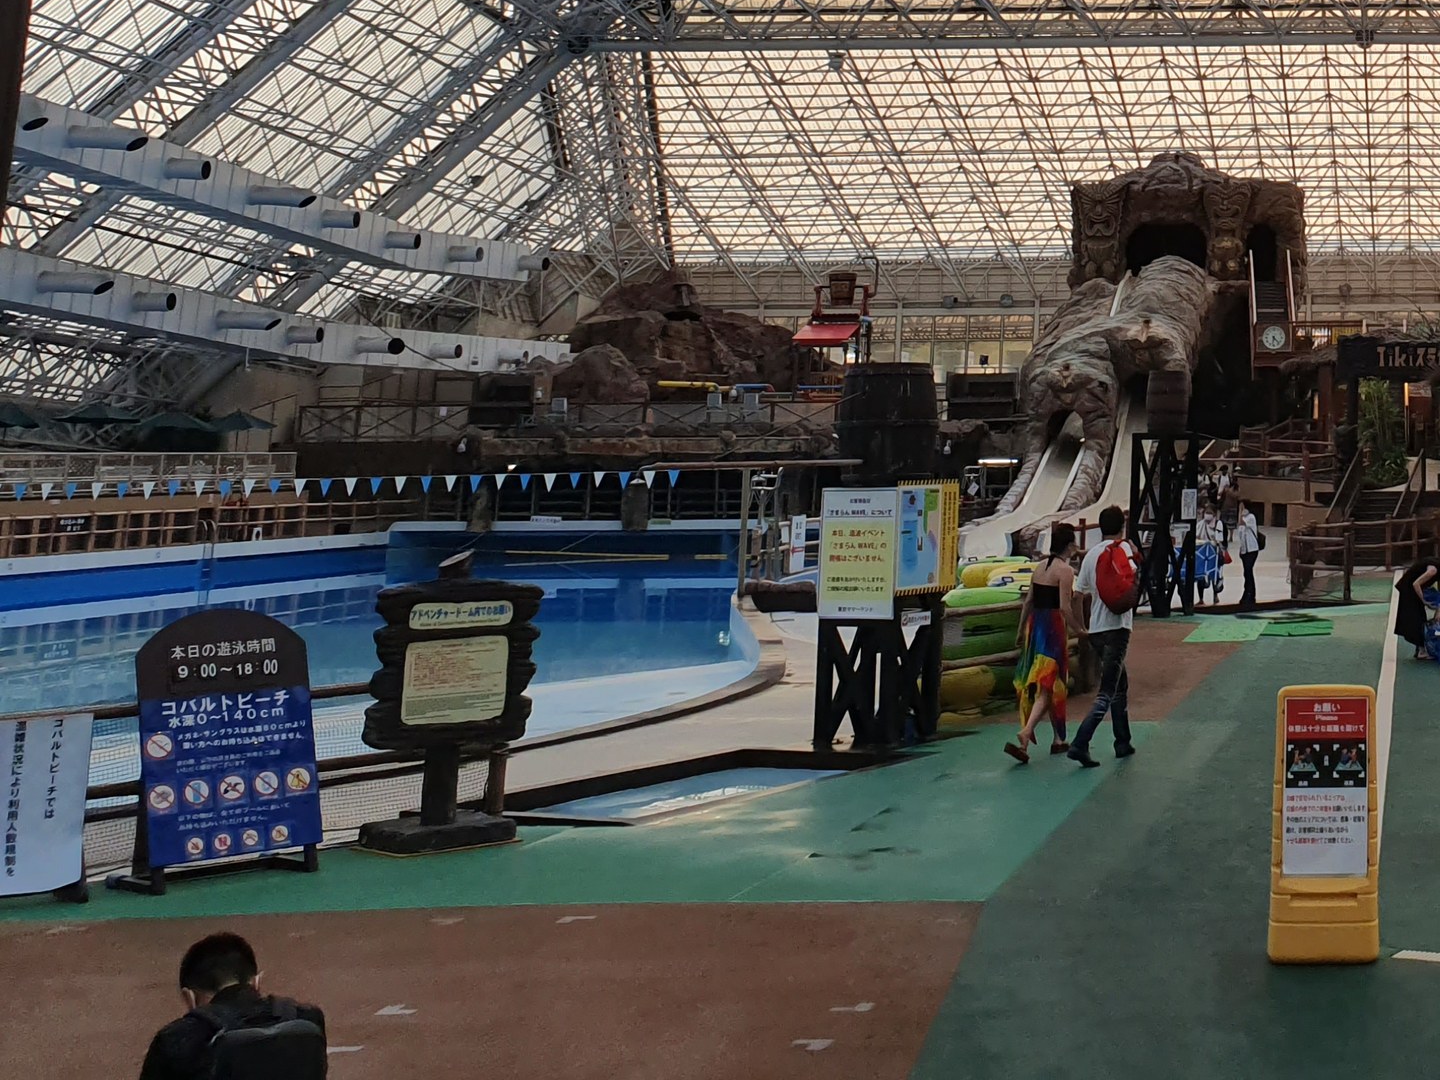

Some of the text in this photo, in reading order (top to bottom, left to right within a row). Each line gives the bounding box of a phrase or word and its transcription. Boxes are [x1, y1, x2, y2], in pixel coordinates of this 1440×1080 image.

[171, 638, 276, 660] 本日の遊泳時間
[161, 690, 290, 715] コバルトビーチ
[1313, 702, 1340, 712] お願い
[44, 719, 63, 819] コバルトビーチでは
